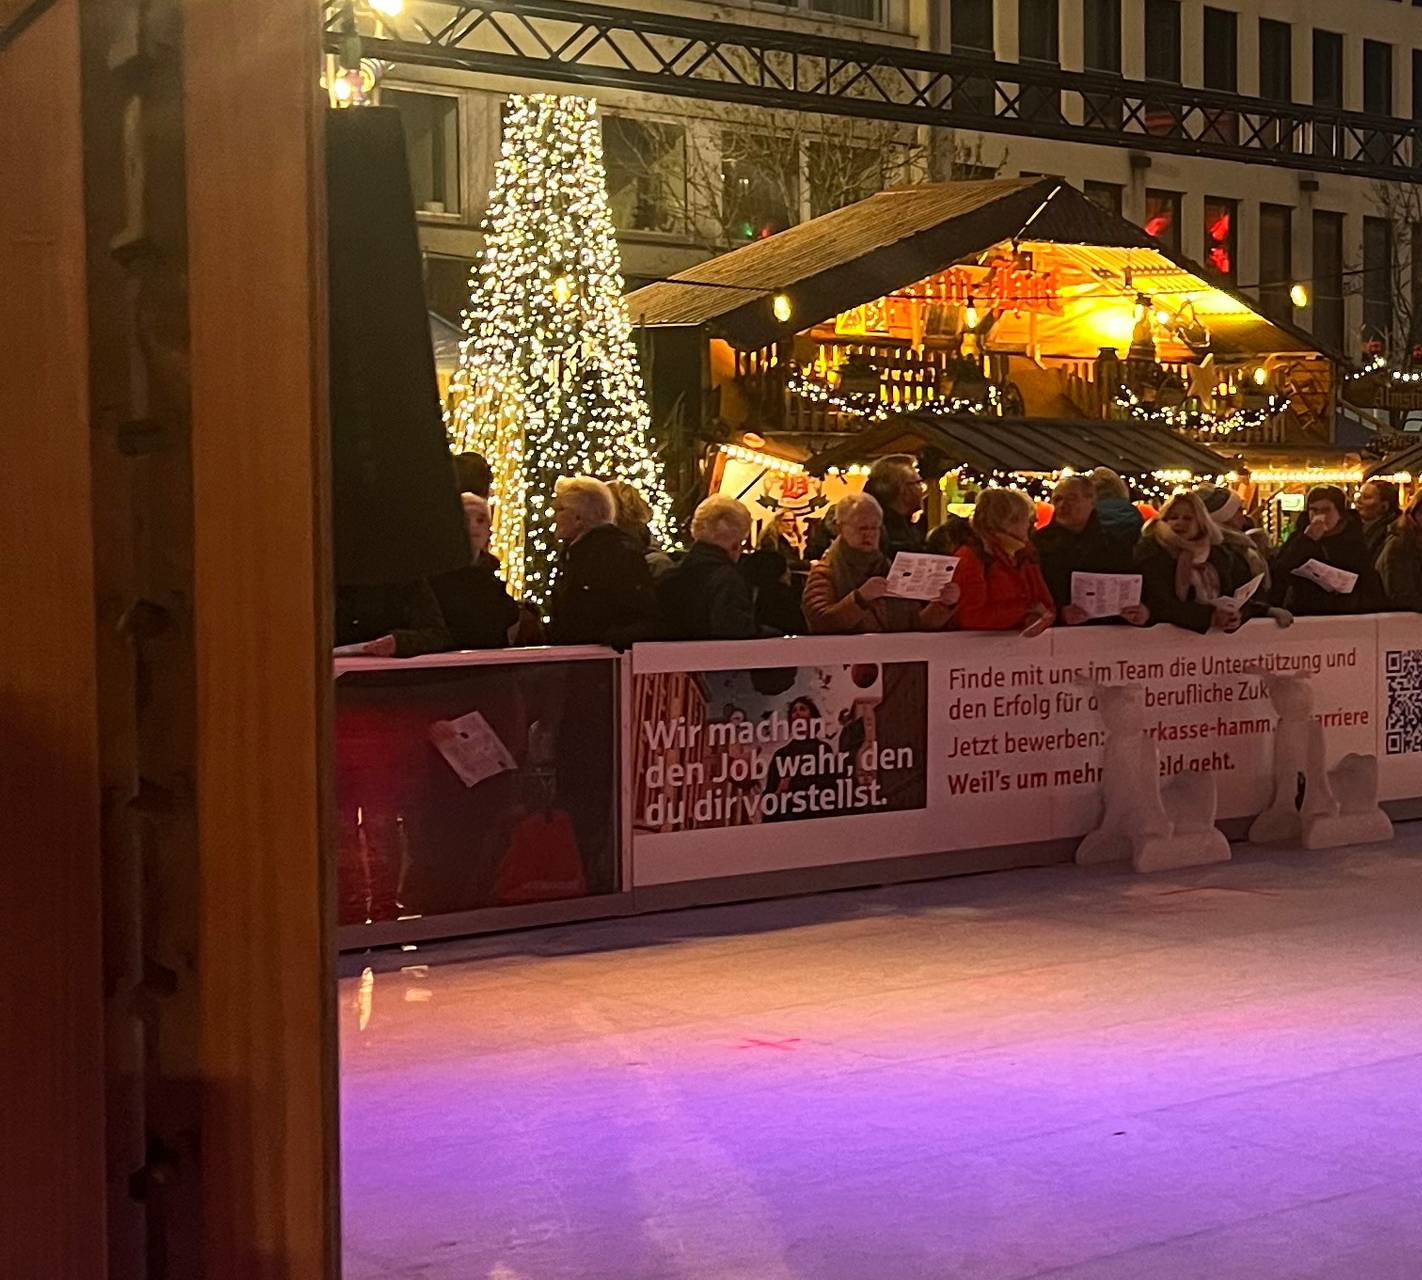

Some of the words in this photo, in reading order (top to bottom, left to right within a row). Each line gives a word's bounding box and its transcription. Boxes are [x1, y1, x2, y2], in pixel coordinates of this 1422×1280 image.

[950, 665, 1006, 690] Finde
[1011, 664, 1043, 687] mit
[1089, 661, 1112, 683] im
[1117, 659, 1164, 680] Team
[1169, 656, 1197, 677] die
[1202, 652, 1321, 676] Unterstützung
[1327, 648, 1356, 667] und
[949, 698, 987, 720] den
[994, 693, 1050, 720] Erfolg
[1056, 691, 1083, 713] für
[1145, 683, 1233, 707] berufliche
[644, 716, 701, 751] Wir
[708, 710, 825, 749] machen
[948, 735, 999, 758] Jetzt
[1005, 728, 1105, 754] bewerben:
[646, 755, 704, 789] den
[713, 750, 768, 784] Job
[776, 744, 854, 779] wahr,
[861, 741, 913, 773] den
[948, 768, 1011, 796] Weil's
[1017, 771, 1048, 789] um
[646, 795, 686, 827] du
[694, 789, 742, 822] dir
[742, 778, 888, 820] vorstellst.
